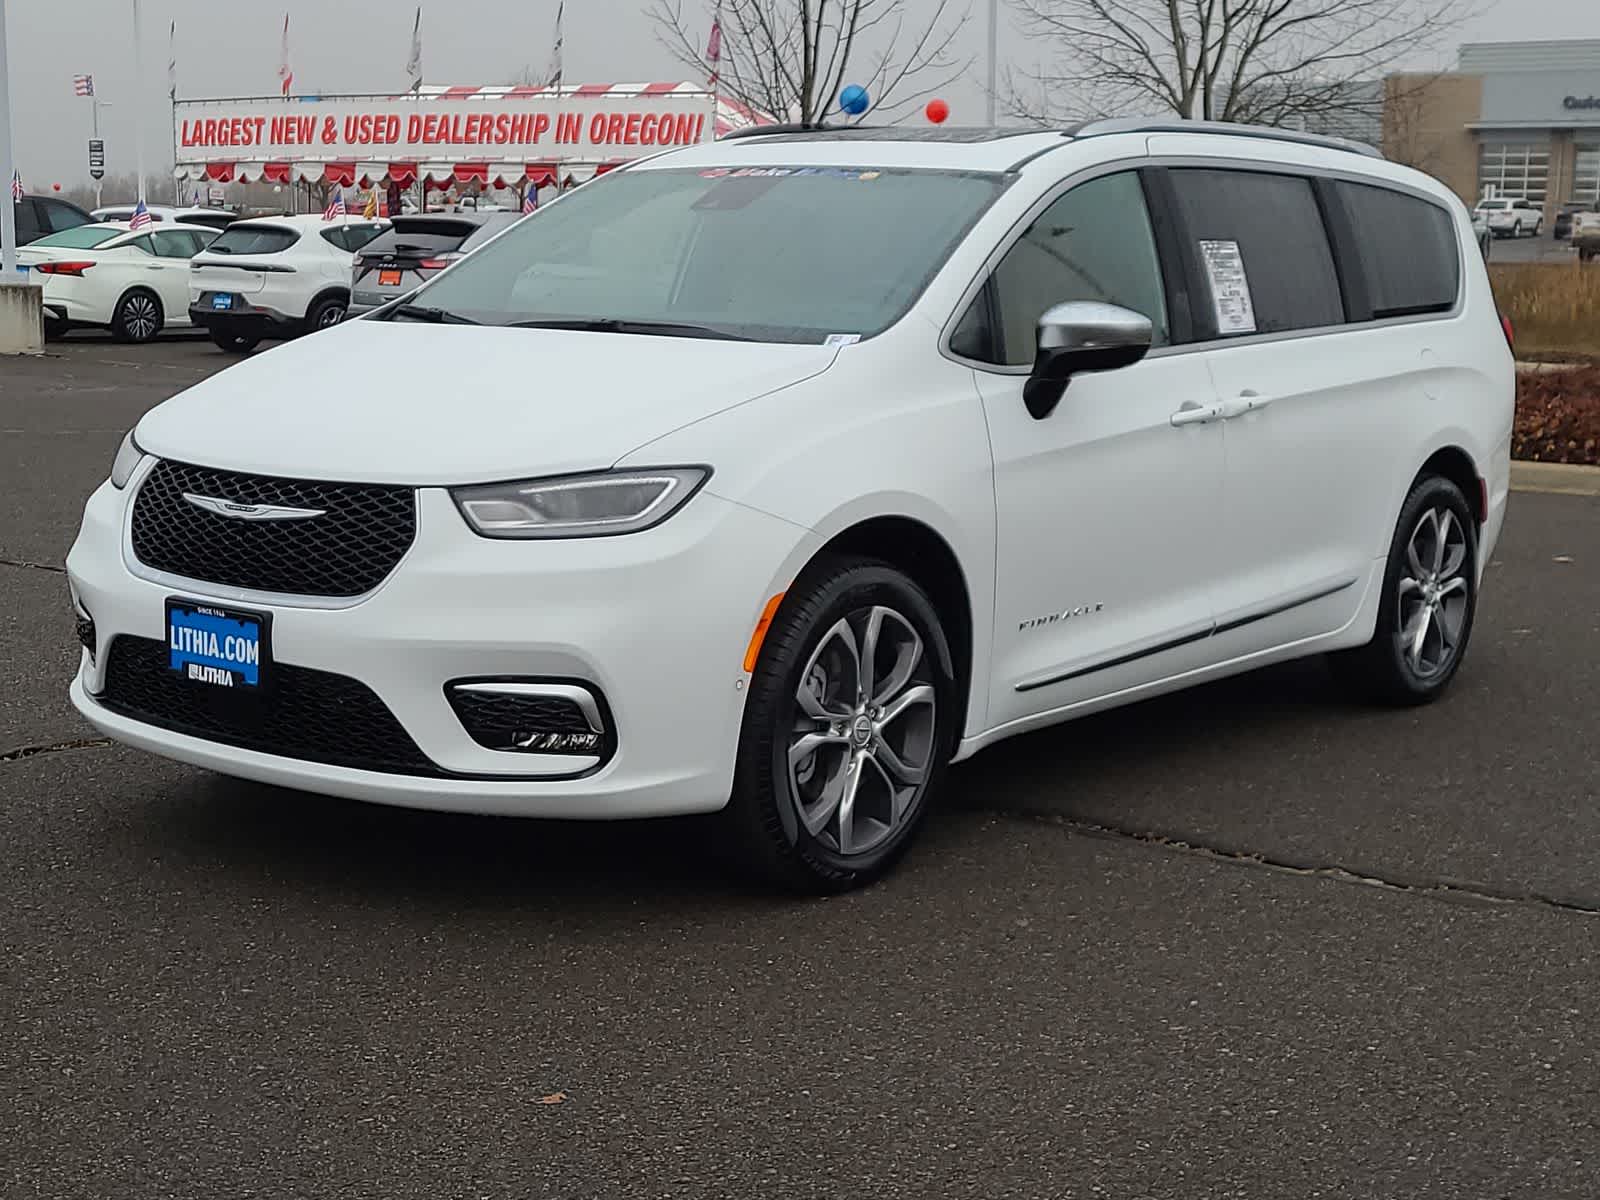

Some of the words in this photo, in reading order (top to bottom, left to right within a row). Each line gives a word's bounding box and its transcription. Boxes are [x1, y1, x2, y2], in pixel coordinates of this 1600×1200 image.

[181, 118, 266, 146] LARGEST
[269, 115, 317, 145] NEW
[321, 115, 338, 145] &
[344, 115, 402, 145] USED
[407, 113, 550, 145] DEALERSHIP
[554, 113, 585, 145] IN
[589, 113, 705, 145] OREGON!
[1018, 601, 1105, 632] PINNACLE
[171, 625, 259, 666] LITHIA.COM
[199, 665, 233, 687] LITHIA
